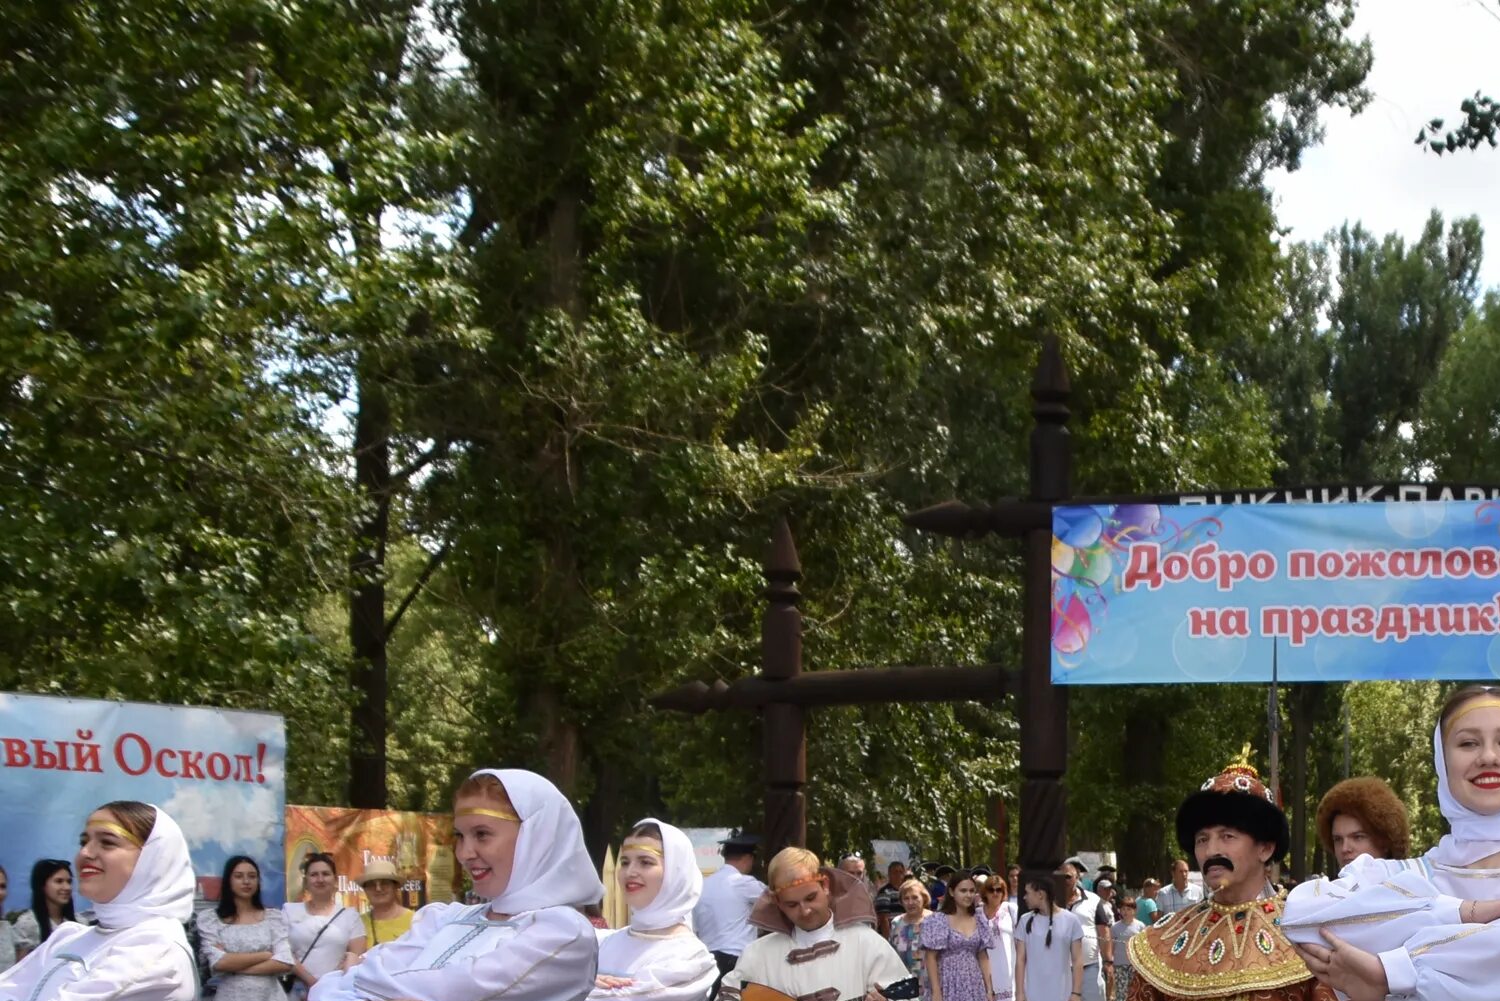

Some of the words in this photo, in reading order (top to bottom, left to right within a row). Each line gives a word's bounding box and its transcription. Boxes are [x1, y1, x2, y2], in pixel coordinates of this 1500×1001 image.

[1124, 543, 1276, 589] Добро
[1190, 608, 1249, 637] на
[113, 732, 267, 784] Оскол!
